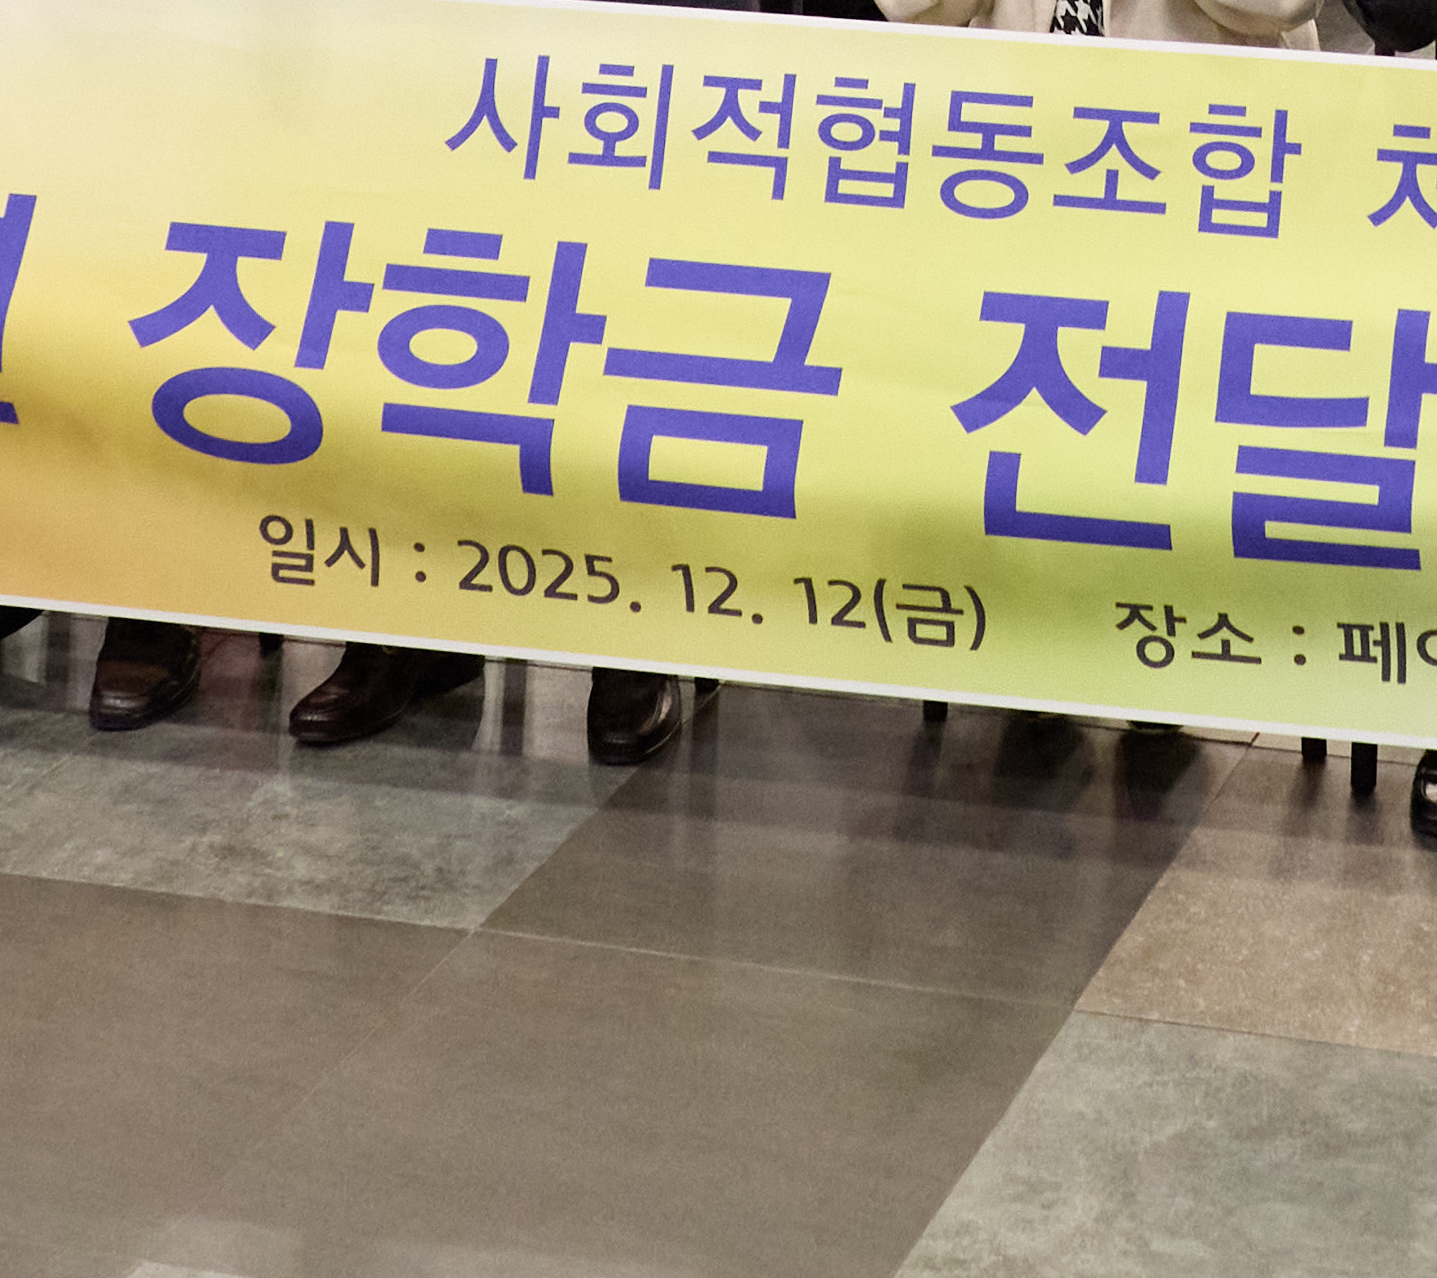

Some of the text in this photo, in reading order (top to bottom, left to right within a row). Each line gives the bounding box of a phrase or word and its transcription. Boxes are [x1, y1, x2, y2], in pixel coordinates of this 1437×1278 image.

[443, 55, 1302, 240] 사회적협동조합
[129, 219, 842, 520] 장학금
[258, 514, 381, 588] 일시
[456, 539, 643, 613] 2025.
[670, 563, 764, 625] 12.
[793, 576, 987, 652] 12(금)
[1114, 601, 1263, 670] 장소
